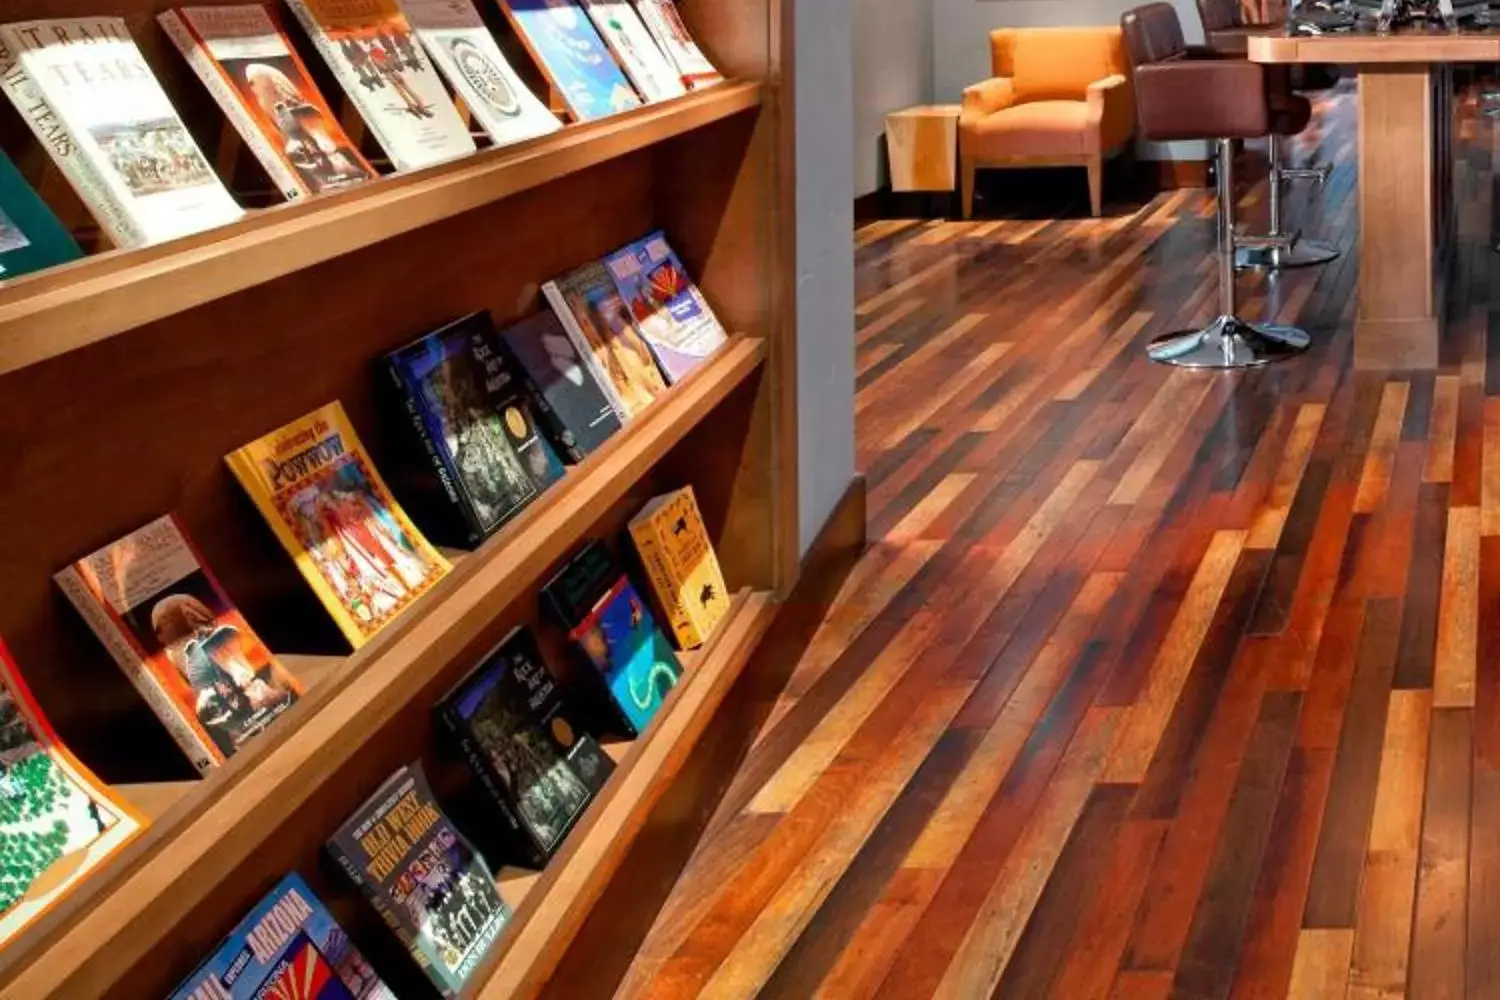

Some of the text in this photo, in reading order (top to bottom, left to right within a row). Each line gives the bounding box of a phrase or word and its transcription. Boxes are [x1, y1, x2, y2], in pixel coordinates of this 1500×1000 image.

[28, 96, 78, 157] TEARS
[266, 432, 345, 491] POWWOW
[360, 822, 392, 858] OLD
[384, 789, 422, 829] WEST
[365, 833, 413, 884] TRIVIA
[402, 802, 441, 845] BOOK
[246, 887, 314, 965] ARIZONA
